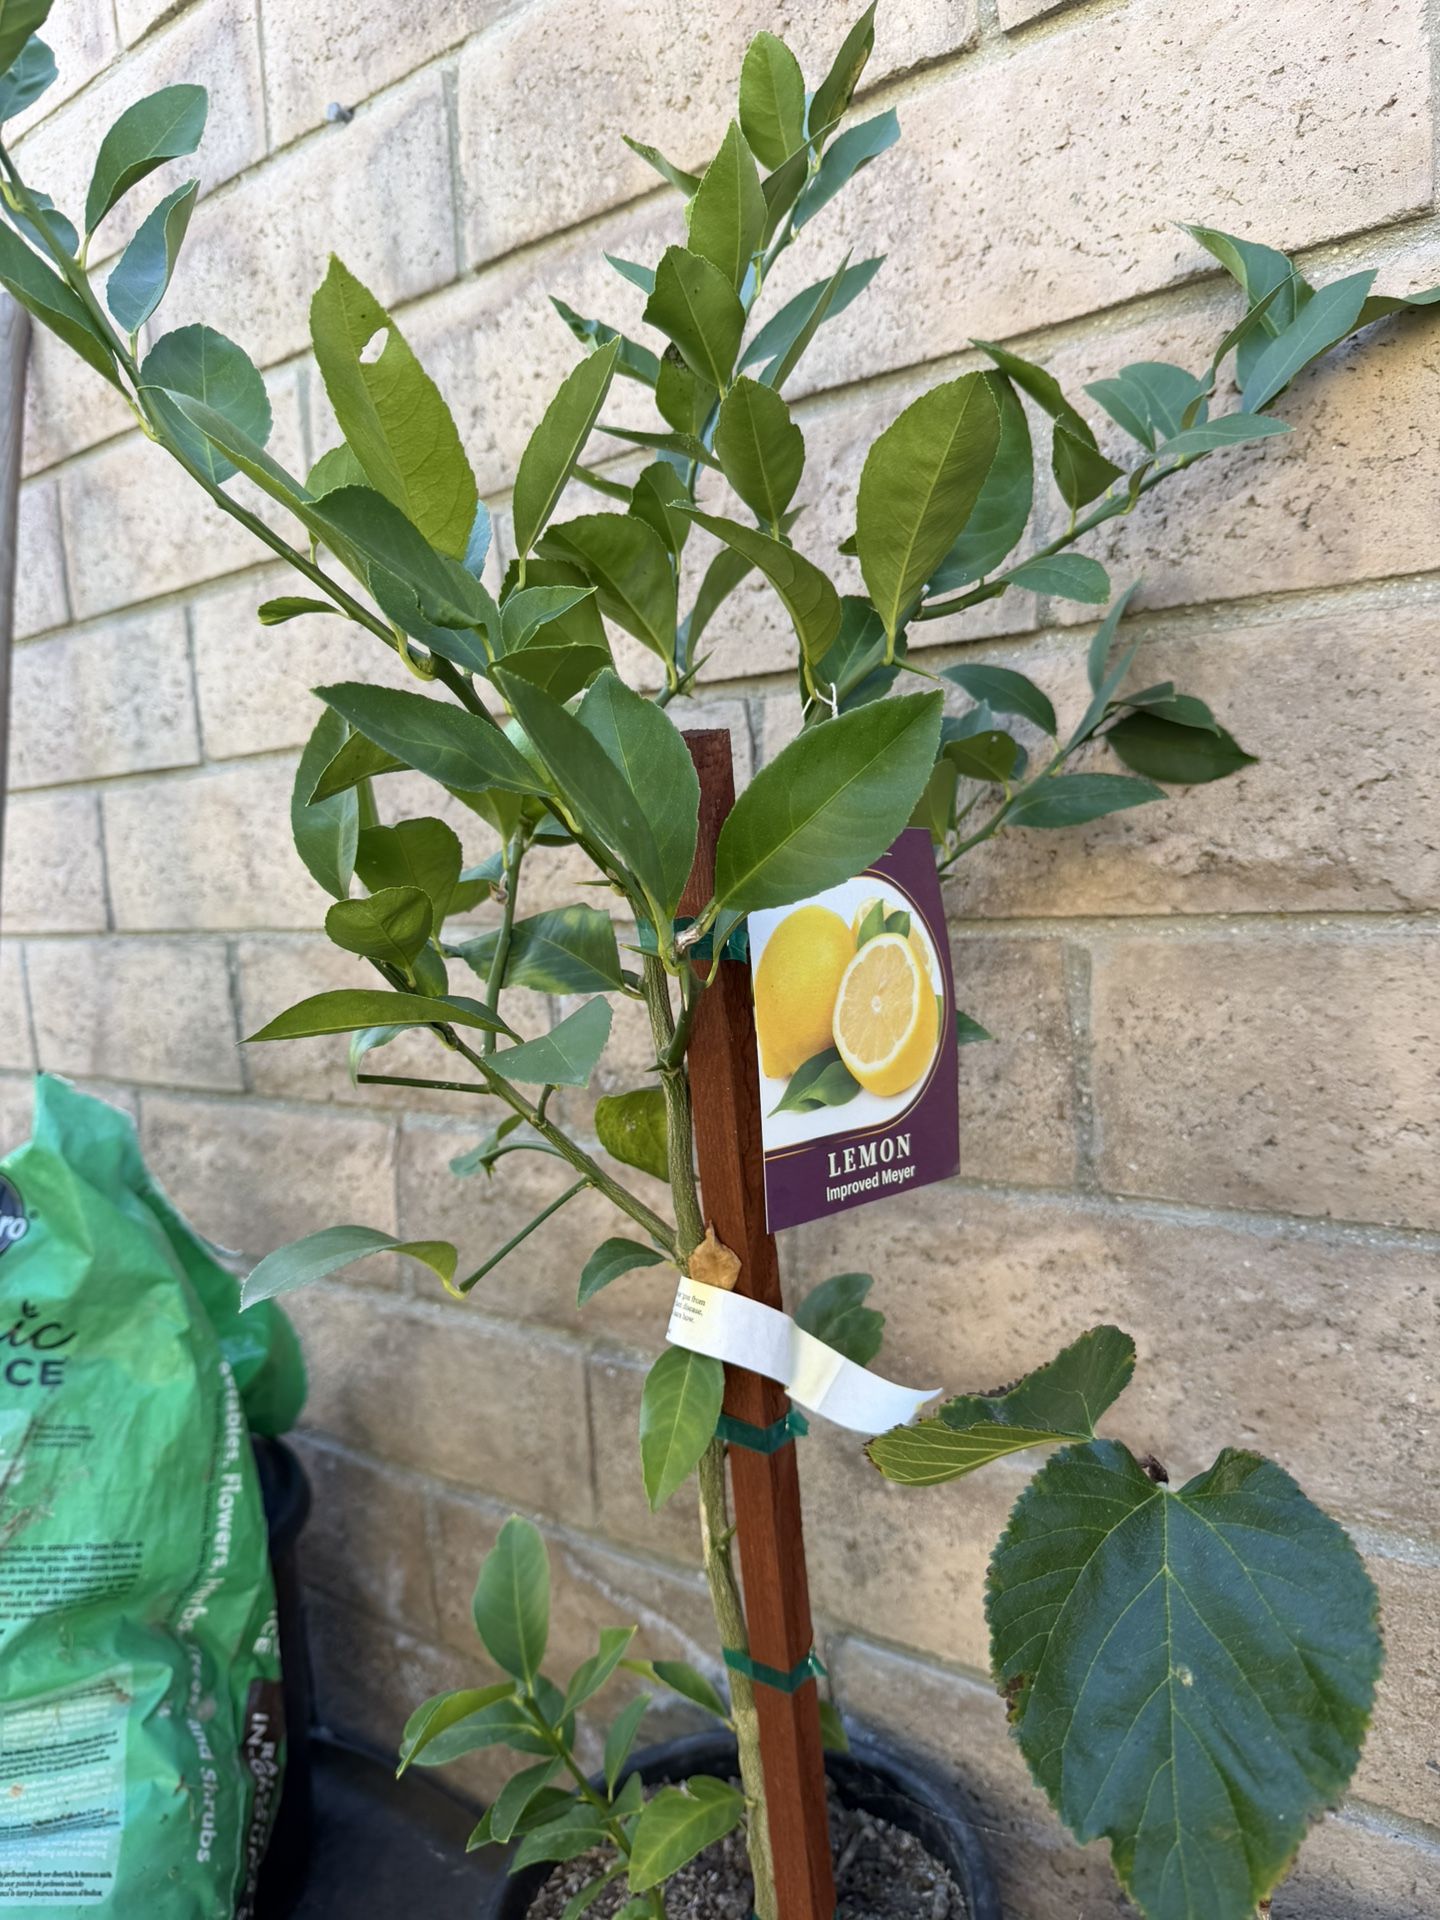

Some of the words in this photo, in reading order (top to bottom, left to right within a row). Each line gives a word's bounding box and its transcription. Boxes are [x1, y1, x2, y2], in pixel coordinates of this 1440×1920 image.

[828, 1133, 911, 1178] LEMON
[826, 1171, 879, 1202] Improved
[881, 1165, 915, 1184] Meyer
[197, 1765, 218, 1863] Shrubs
